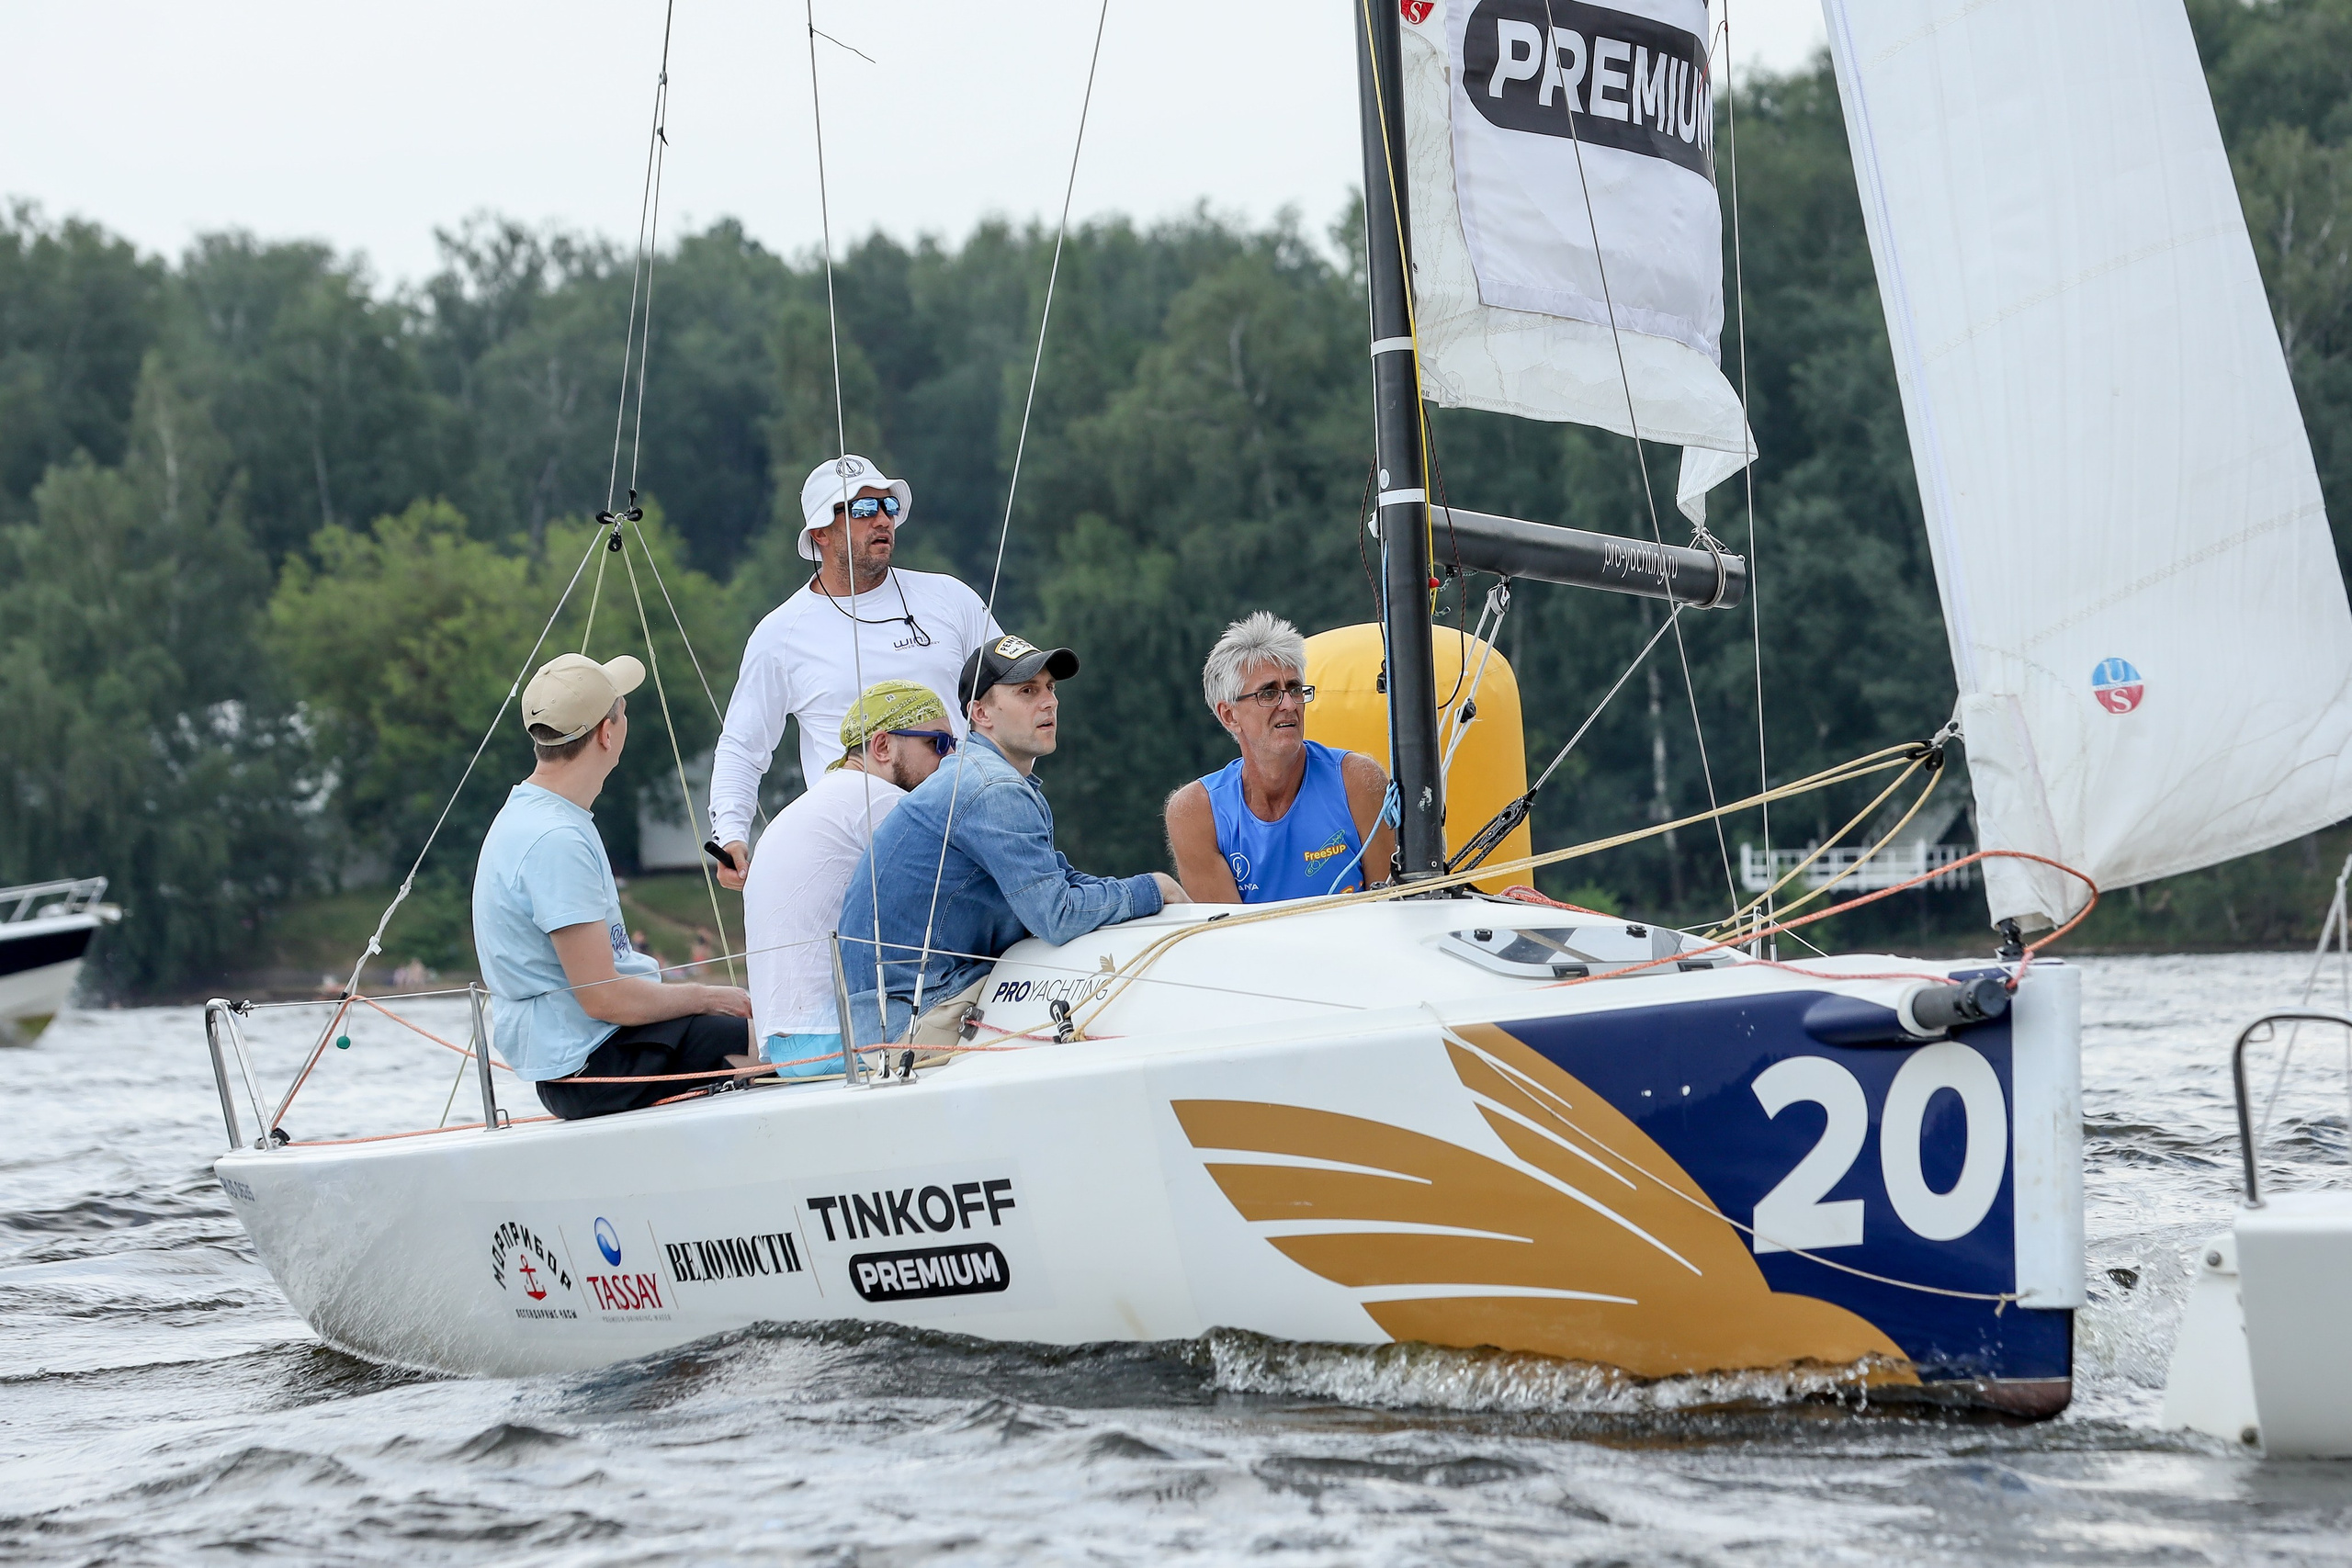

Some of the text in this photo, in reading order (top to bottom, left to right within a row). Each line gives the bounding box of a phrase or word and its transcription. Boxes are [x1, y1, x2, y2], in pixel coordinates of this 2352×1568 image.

[1488, 17, 1711, 162] PREMIUM
[1304, 844, 1348, 862] FreeSUP
[991, 978, 1109, 1003] PROYACHTING
[1750, 1041, 2008, 1255] 20
[807, 1179, 1015, 1242] TINKOFF
[492, 1221, 572, 1292] МОРПРИБОР
[665, 1232, 804, 1287] ВЕДОМОСТИ
[856, 1251, 1001, 1294] PREMIUM
[586, 1273, 663, 1311] TASSAY
